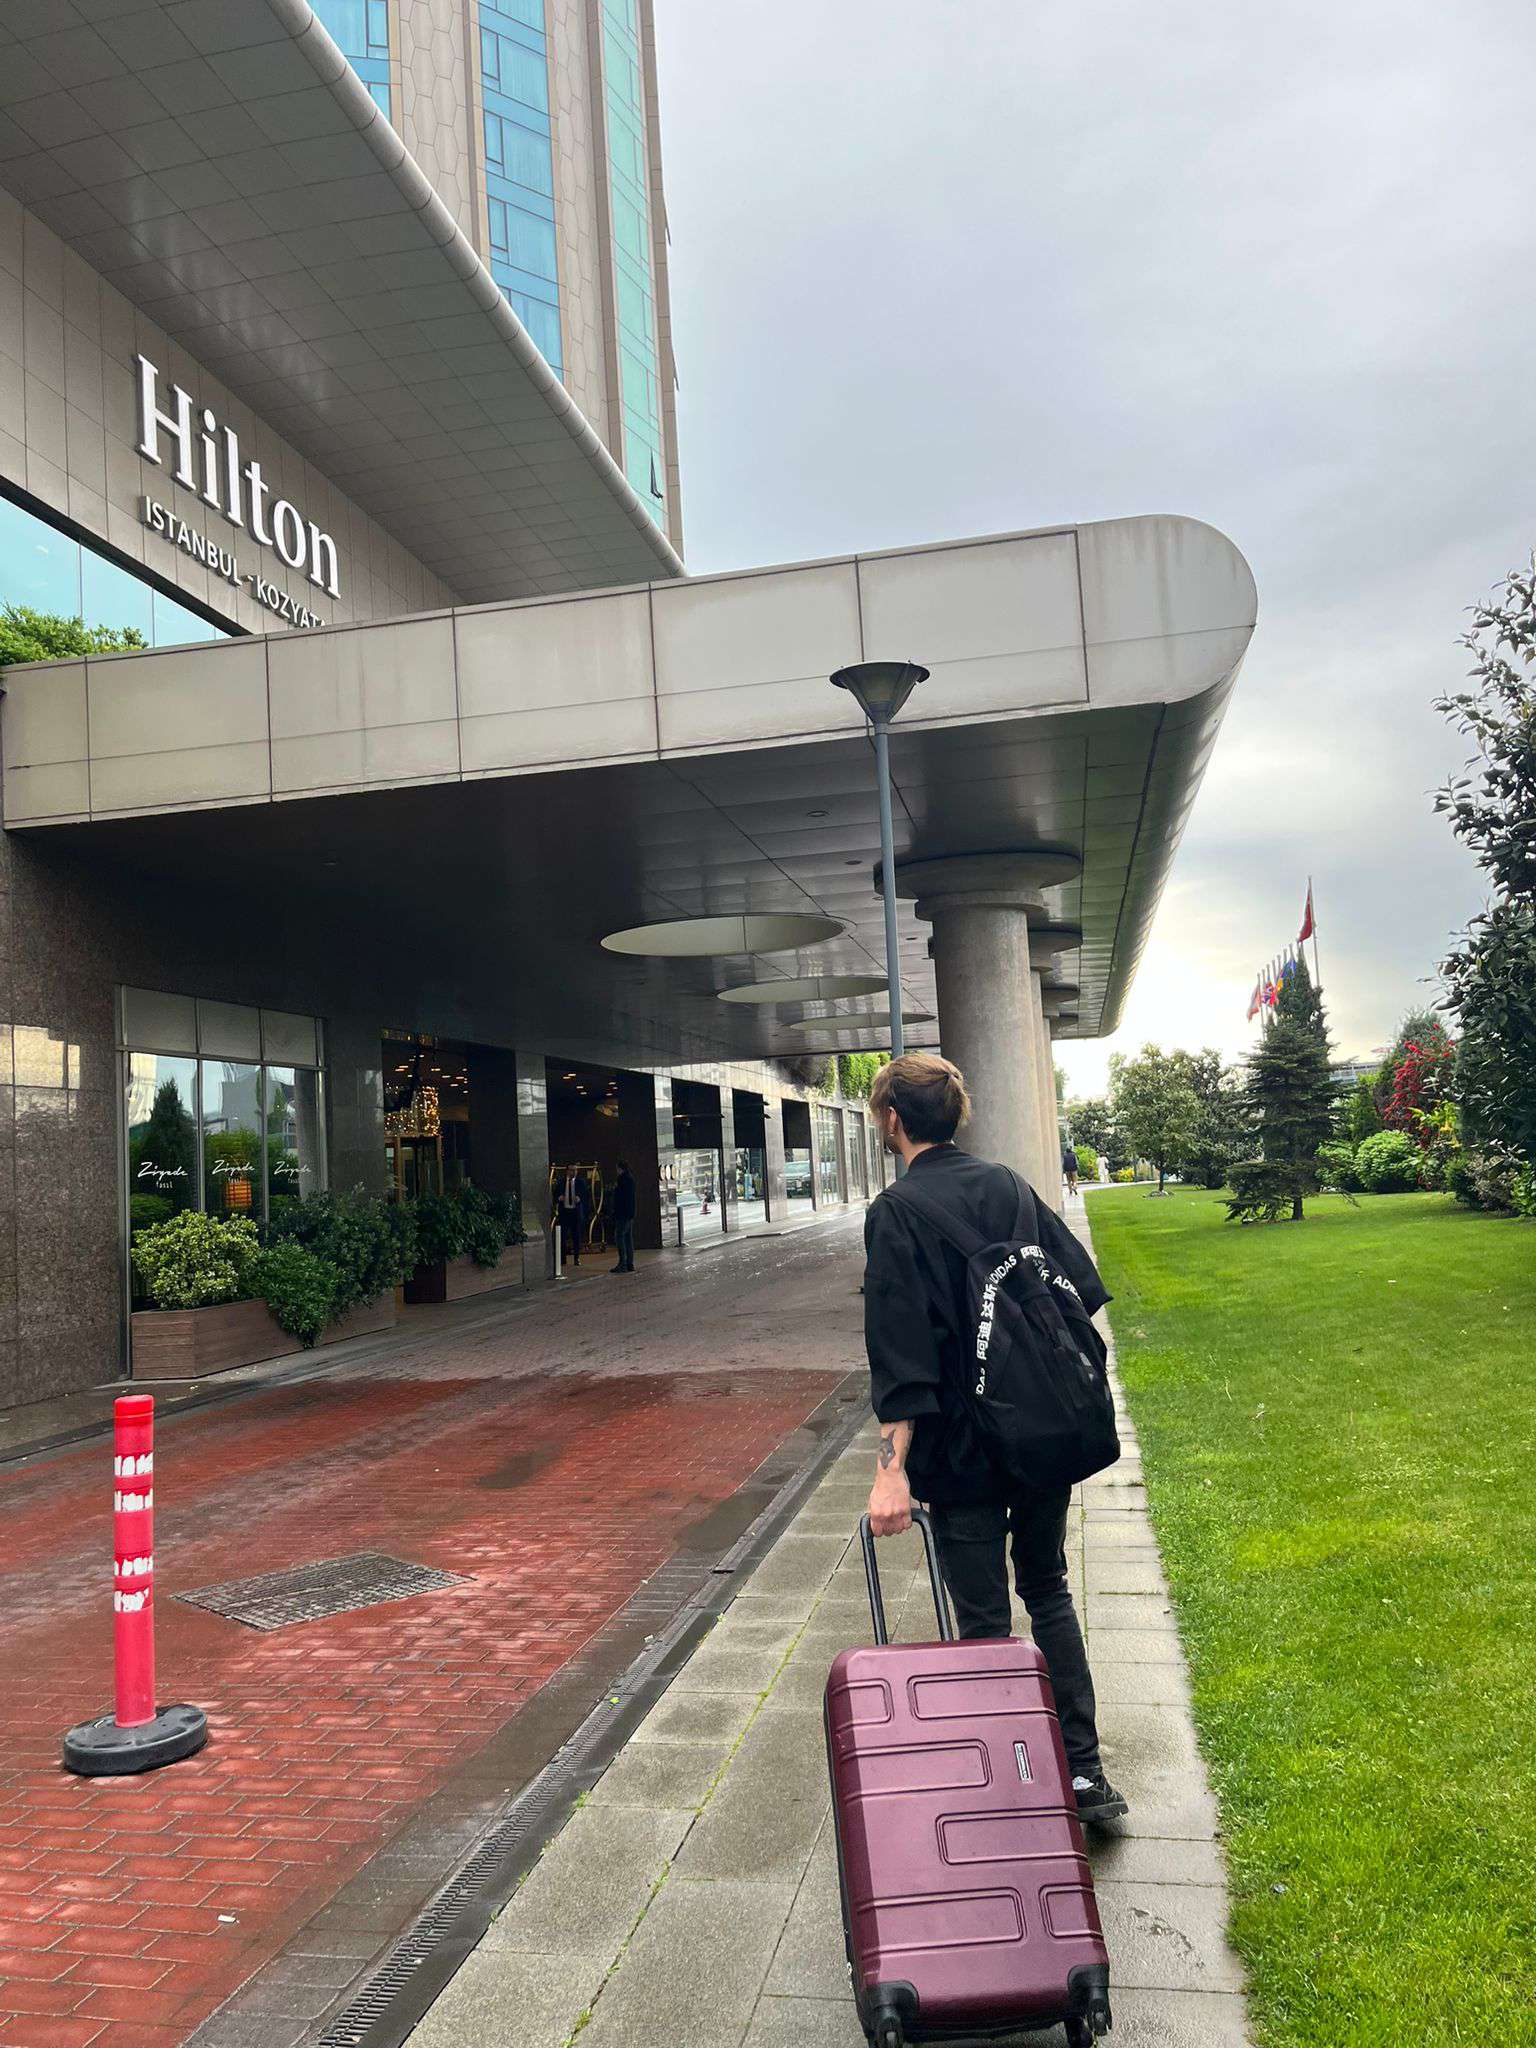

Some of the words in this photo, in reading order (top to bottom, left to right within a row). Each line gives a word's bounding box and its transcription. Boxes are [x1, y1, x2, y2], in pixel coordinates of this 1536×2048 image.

[138, 354, 341, 599] Hilton
[145, 496, 243, 586] ISTANBUL
[989, 1254, 1017, 1285] DIDAS
